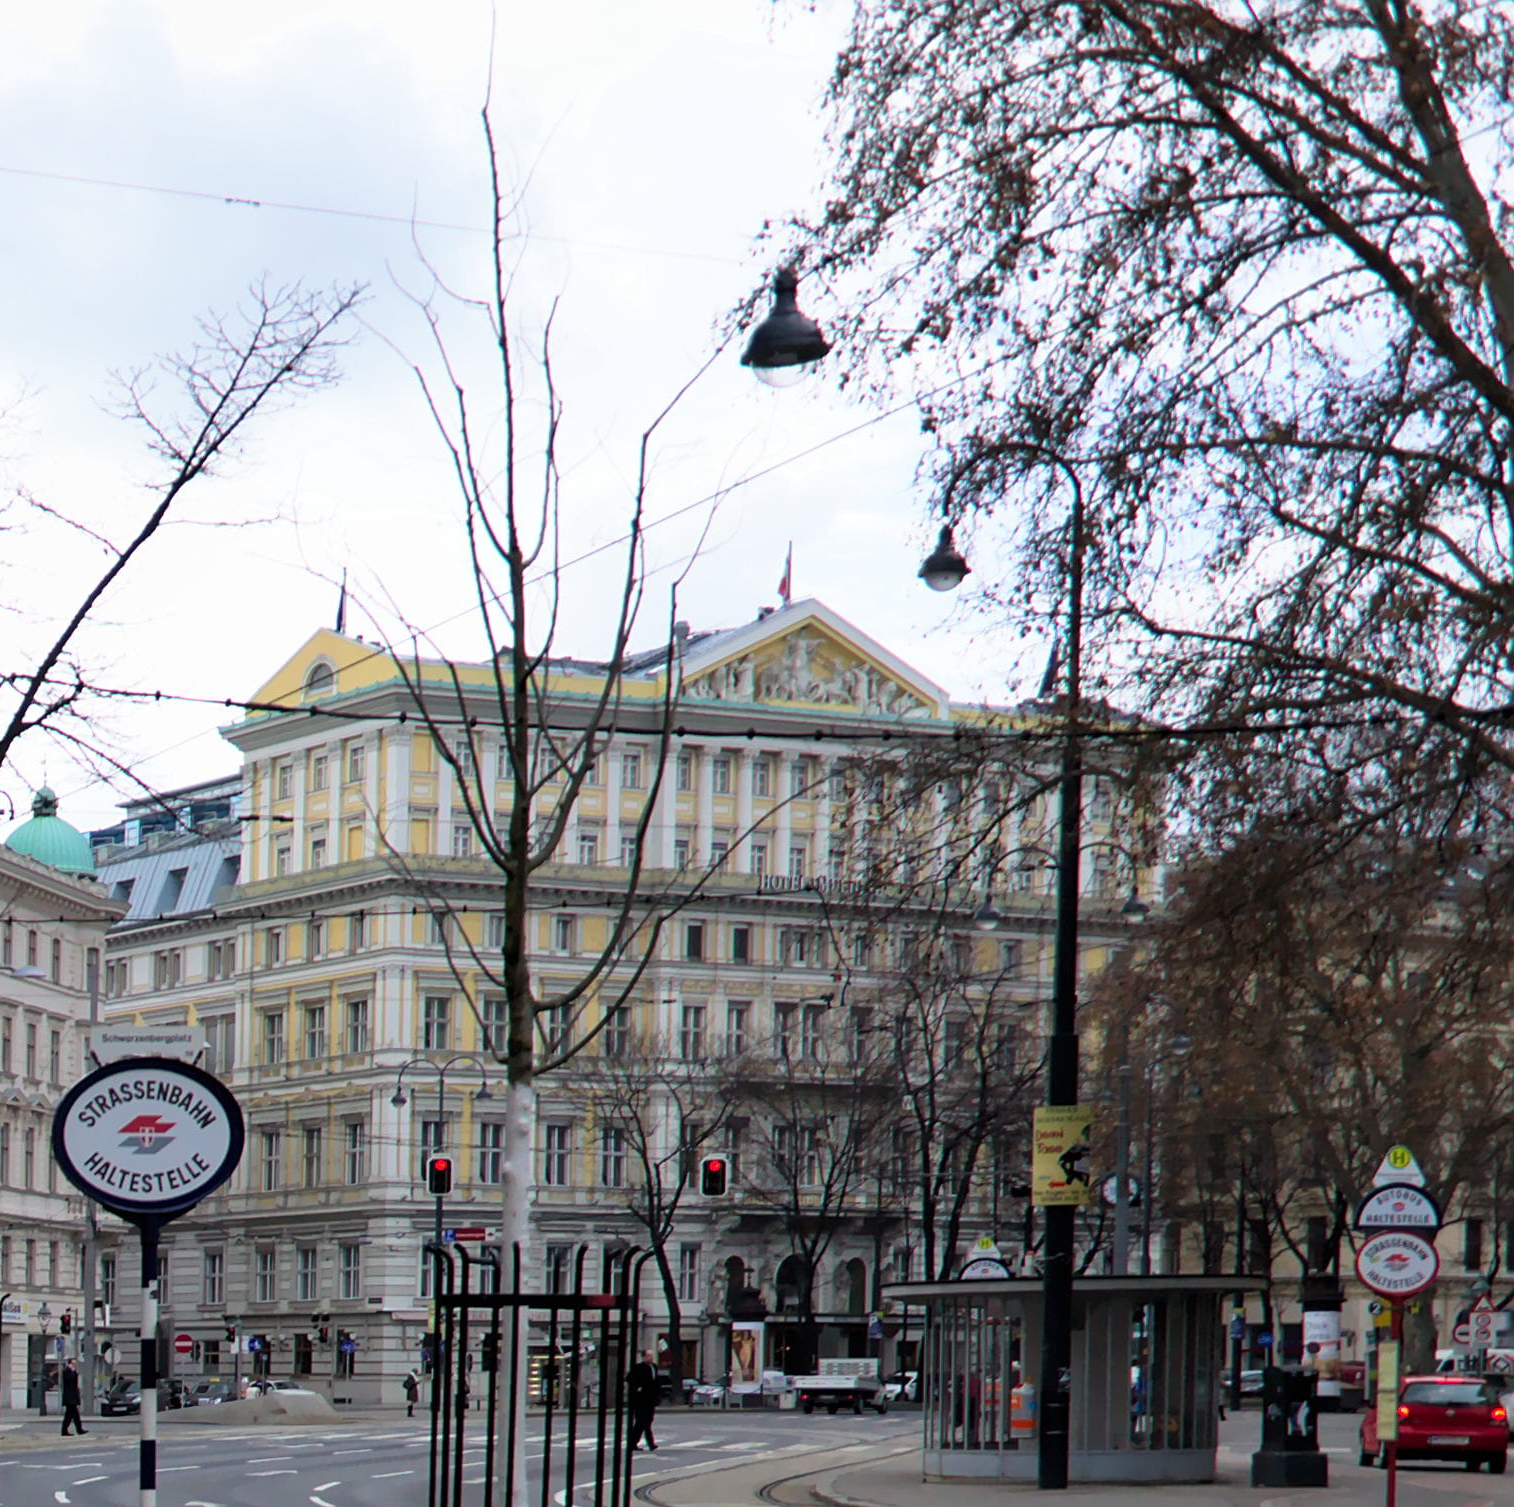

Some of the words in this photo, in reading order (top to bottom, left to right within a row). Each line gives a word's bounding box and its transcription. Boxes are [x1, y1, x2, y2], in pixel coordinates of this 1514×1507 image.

[101, 1033, 192, 1044] Schwarzenbergplatz
[78, 1080, 217, 1129] STRASSENBAHN
[1393, 1151, 1405, 1164] H
[83, 1152, 211, 1193] HALTESTELLE
[1376, 1190, 1424, 1207] AUTOBUS
[1366, 1214, 1430, 1224] HALTESTELLE
[1364, 1238, 1429, 1262] STRASSENBAHN
[1367, 1270, 1426, 1290] HALTESTELLE
